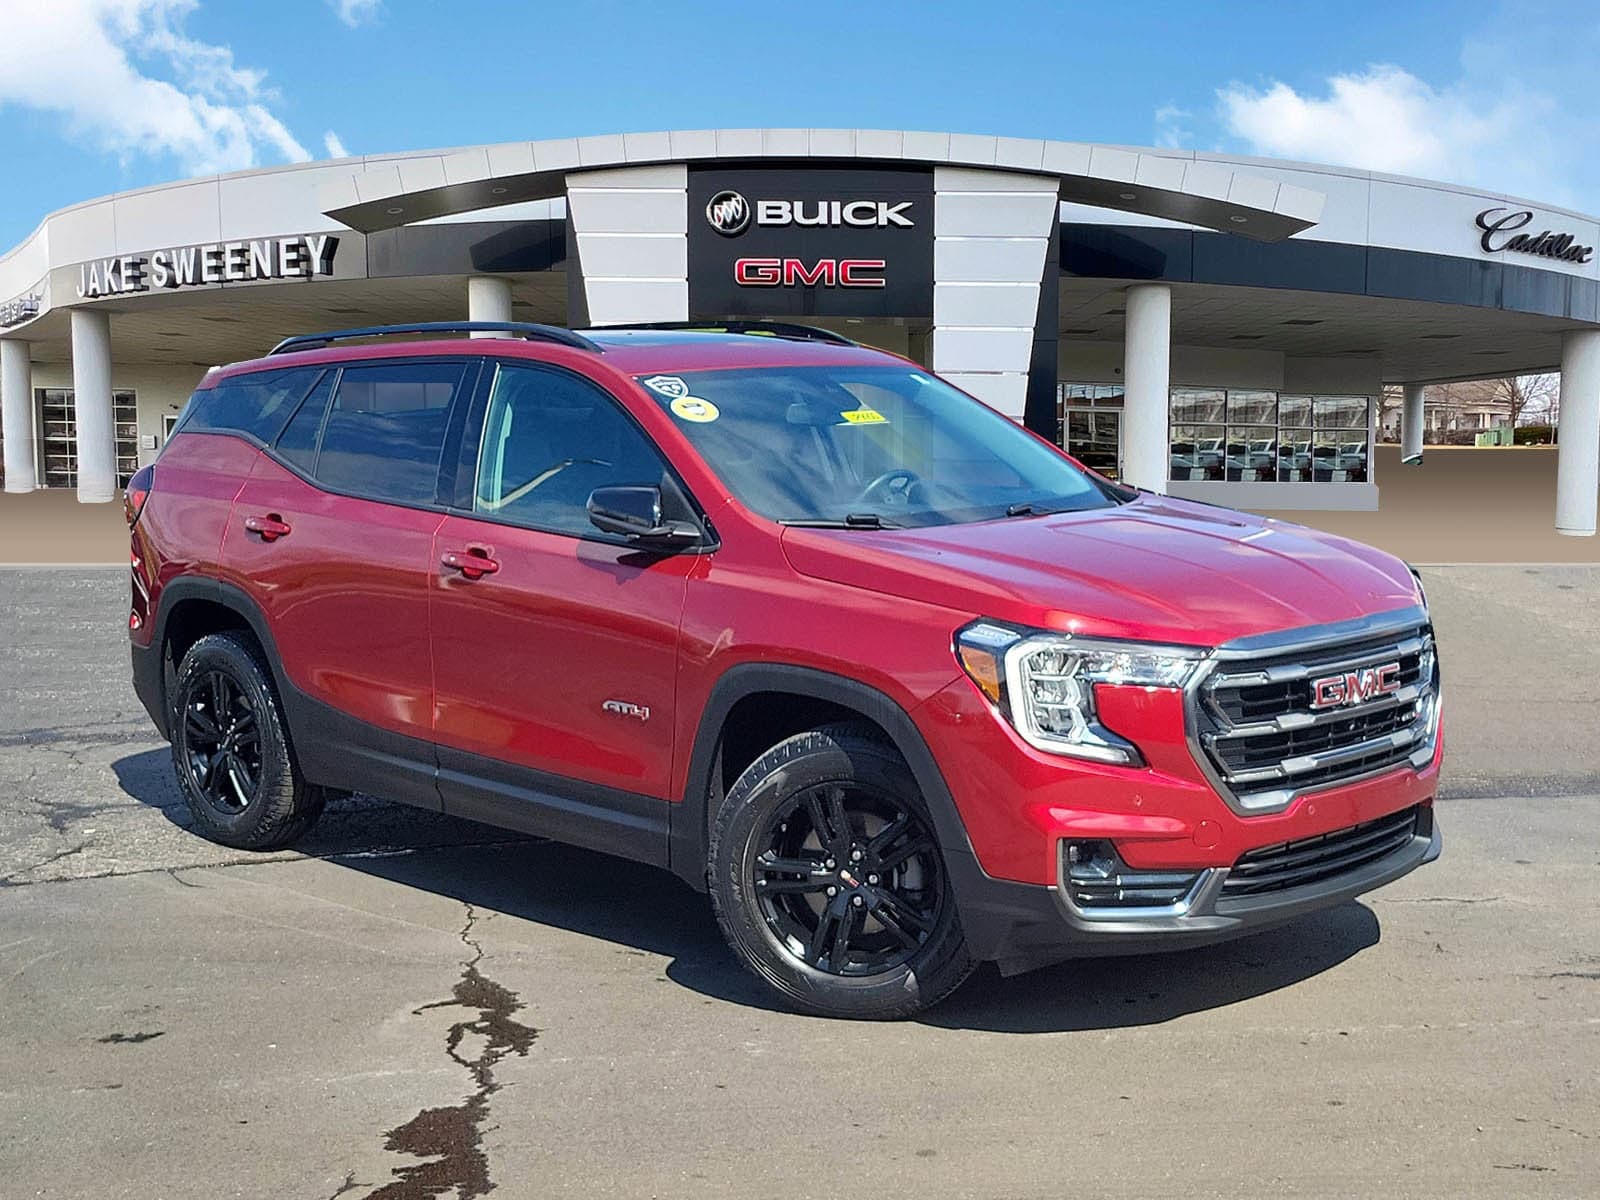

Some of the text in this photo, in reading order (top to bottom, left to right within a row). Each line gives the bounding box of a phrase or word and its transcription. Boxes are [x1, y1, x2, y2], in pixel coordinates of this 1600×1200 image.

[757, 200, 915, 227] BUICK
[1475, 207, 1593, 263] Cadillac
[76, 235, 338, 299] JAKE SWEENEY
[735, 258, 886, 287] GMC
[1310, 662, 1400, 709] GMC
